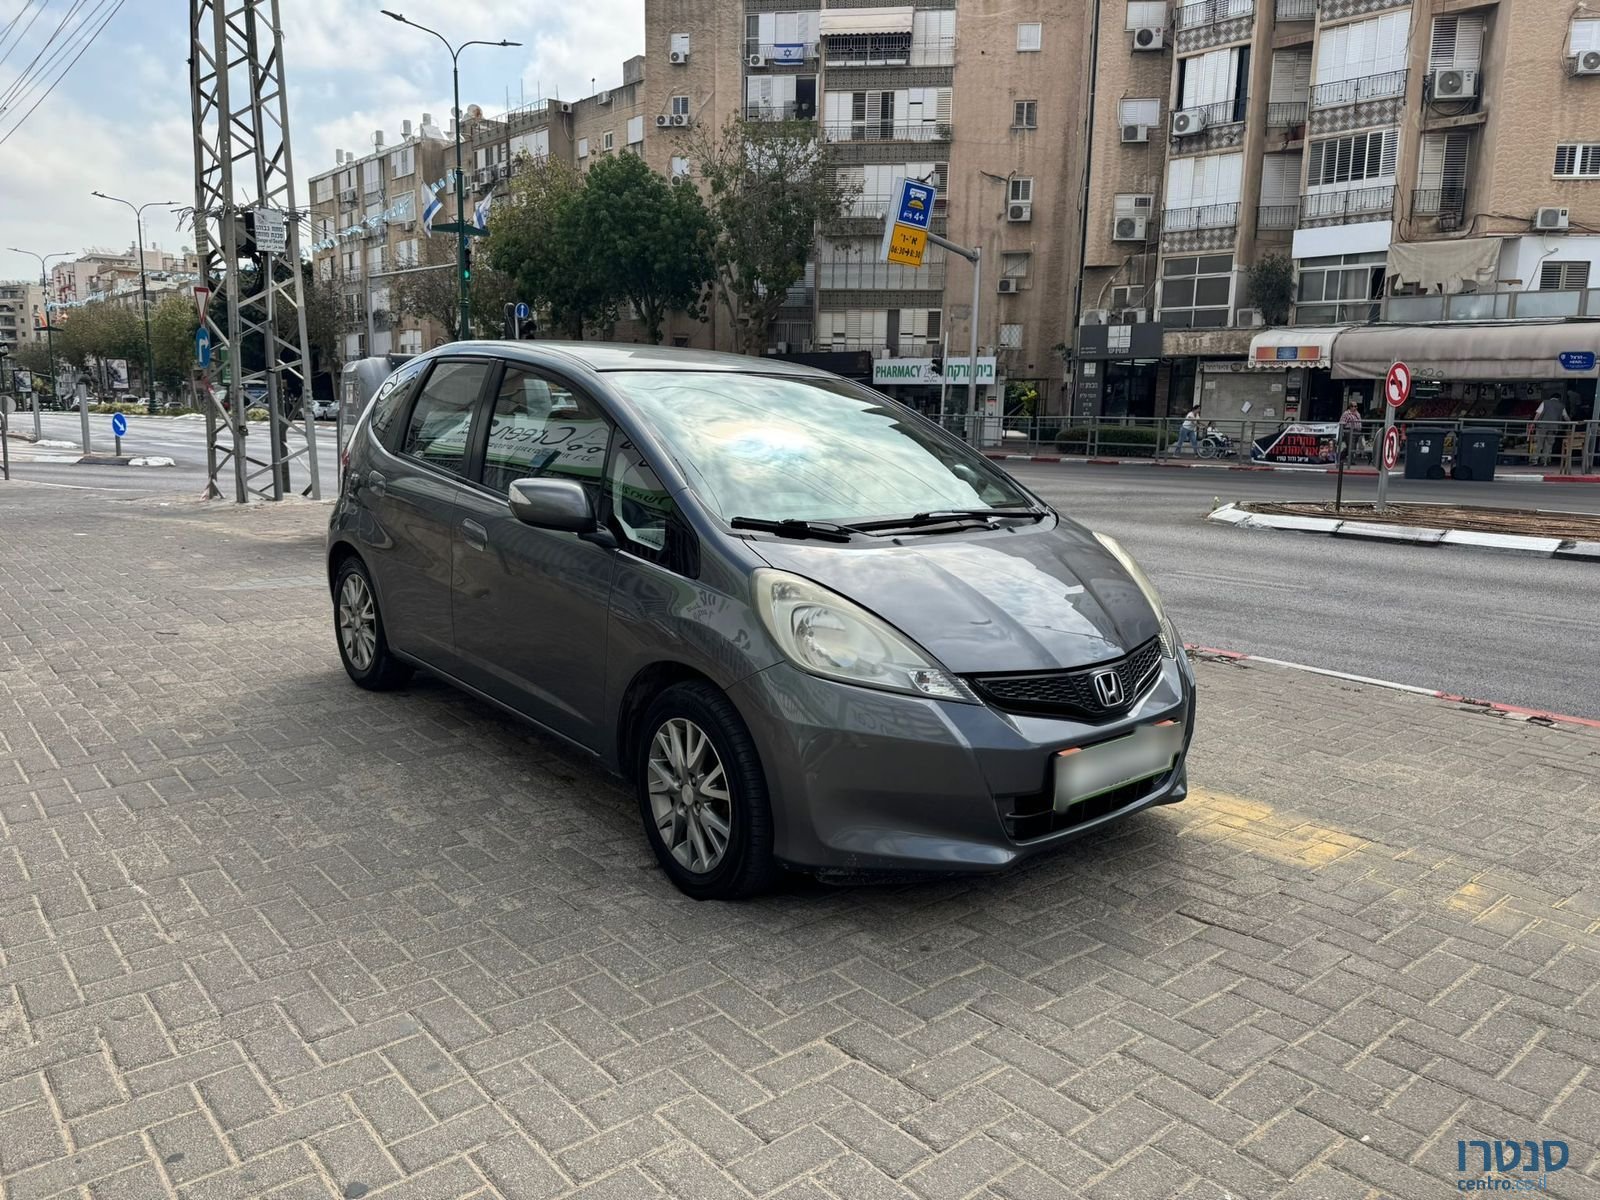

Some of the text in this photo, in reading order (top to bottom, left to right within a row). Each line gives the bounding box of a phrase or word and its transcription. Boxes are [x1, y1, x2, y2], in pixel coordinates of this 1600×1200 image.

[914, 212, 924, 221] 4+
[875, 365, 922, 378] PHARMACY
[976, 364, 993, 377] בית
